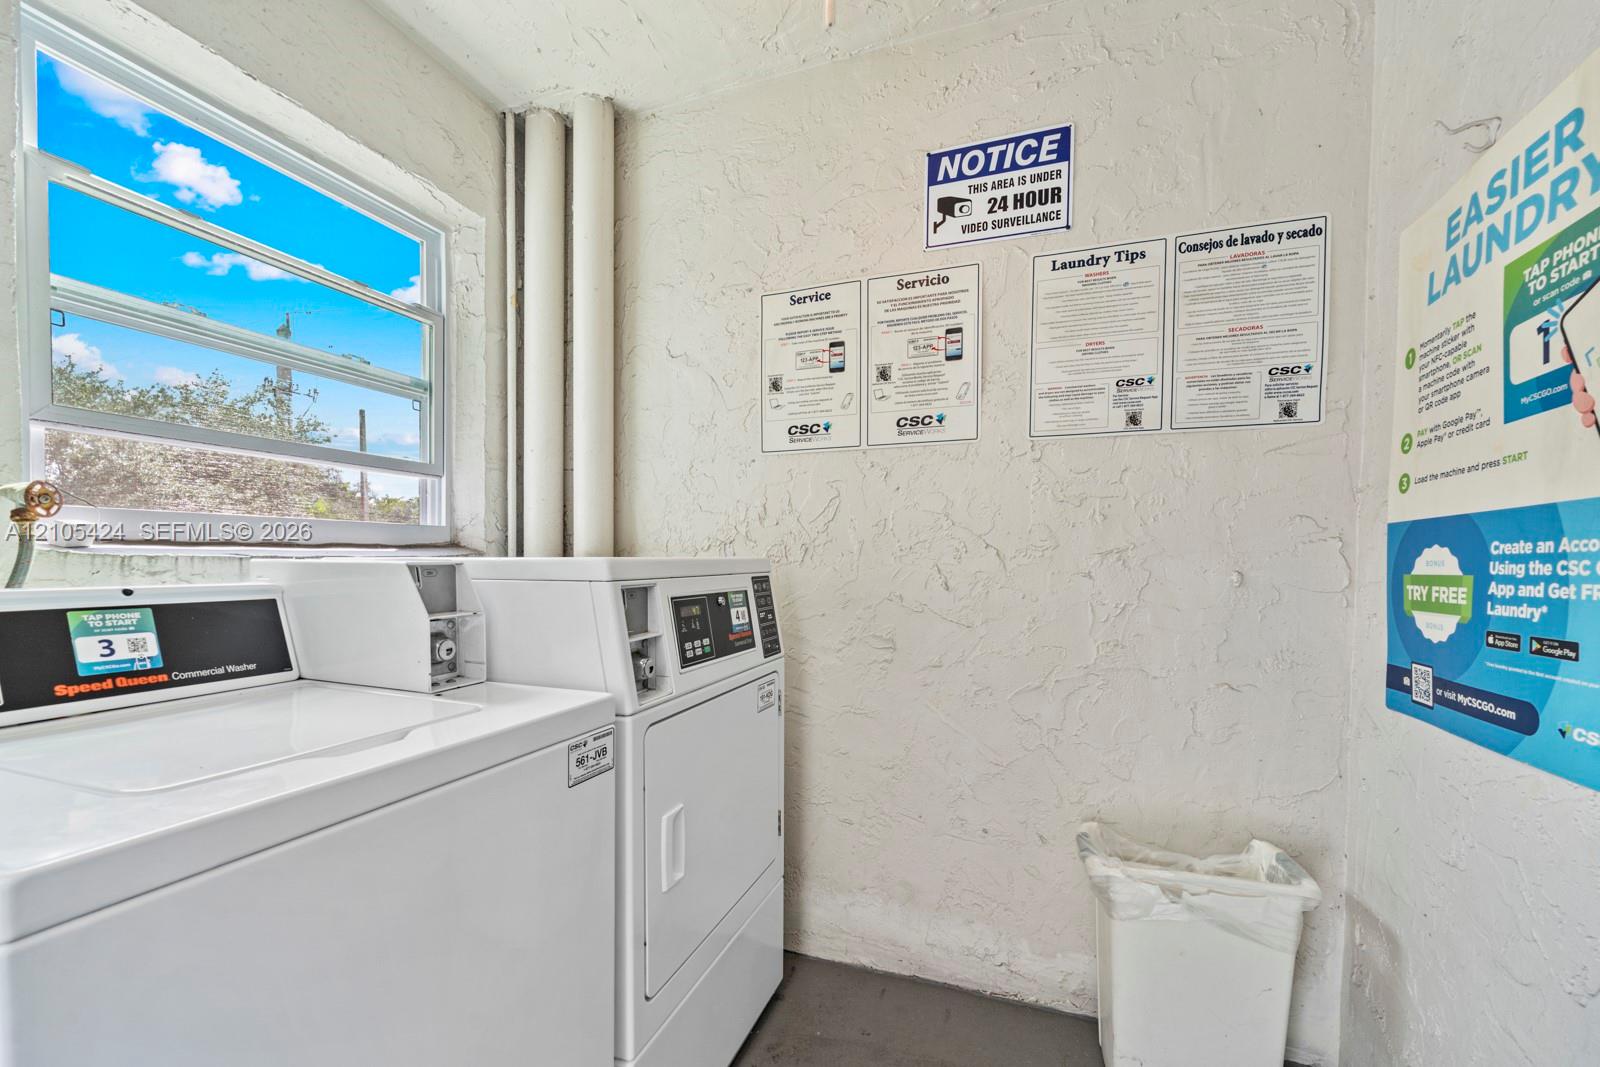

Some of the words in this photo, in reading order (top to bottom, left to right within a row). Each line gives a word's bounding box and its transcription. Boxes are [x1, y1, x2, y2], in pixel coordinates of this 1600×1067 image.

[936, 133, 1062, 182] NOTICE
[968, 182, 988, 195] THIS
[990, 177, 1015, 191] AREA
[1017, 176, 1027, 187] IS
[1030, 169, 1062, 183] UNDER
[1445, 107, 1585, 252] EASIER
[987, 195, 1009, 215] 24
[1012, 186, 1062, 211] HOUR
[961, 221, 988, 235] VIDEO
[991, 210, 1062, 230] SURVEILLANCE
[1426, 151, 1600, 306] LAUNDRY
[1178, 238, 1223, 254] Consejos
[1226, 235, 1239, 248] de
[1241, 230, 1275, 246] lavado
[1277, 231, 1284, 244] y
[1286, 224, 1323, 239] secado
[1051, 254, 1111, 272] Laundry
[1114, 248, 1147, 263] Tips
[1229, 250, 1266, 259] LAVADORAS
[1523, 257, 1550, 282] TAP
[1528, 277, 1547, 295] TO
[1550, 243, 1600, 284] START
[896, 273, 949, 291] Servicio
[1533, 298, 1541, 307] or
[1542, 288, 1559, 302] scan
[1560, 277, 1581, 293] code
[789, 291, 832, 306] Service
[1228, 324, 1264, 333] SECADORAS
[1419, 326, 1452, 349] Momentarily
[1452, 317, 1465, 330] TAP
[1465, 312, 1476, 323] the
[1419, 344, 1440, 361] machine
[1441, 332, 1460, 349] sticker
[1461, 324, 1475, 337] with
[1536, 319, 1550, 365] 1
[1418, 362, 1451, 382] smartphone,
[1452, 354, 1462, 365] OR
[1463, 343, 1482, 360] SCAN
[1419, 360, 1430, 373] your
[1431, 341, 1468, 364] NFC-capable
[1116, 377, 1145, 388] CSC
[1268, 366, 1302, 376] CSC
[1423, 375, 1445, 391] machine
[1446, 367, 1461, 379] code
[1461, 360, 1476, 371] with
[1418, 393, 1430, 405] your
[1430, 377, 1465, 398] smartphone
[1465, 366, 1490, 382] camera
[1417, 406, 1424, 414] or
[1424, 401, 1434, 411] QR
[1434, 395, 1448, 407] code
[1449, 390, 1462, 402] app
[788, 423, 821, 436] CSC
[896, 414, 934, 428] CSC
[1416, 428, 1429, 438] PAY
[1429, 424, 1441, 433] with
[1442, 417, 1464, 430] Google
[1416, 438, 1433, 448] Apple
[1447, 431, 1455, 439] or
[1455, 424, 1474, 436] credit
[1475, 417, 1491, 430] card
[1403, 437, 1410, 450] 2
[1414, 475, 1429, 485] Load
[1429, 472, 1439, 482] the
[1439, 467, 1465, 479] machine
[1466, 463, 1480, 473] and
[1481, 459, 1501, 471] press
[1502, 450, 1528, 465] START
[1401, 478, 1408, 490] 3
[1490, 540, 1533, 555] Create
[1536, 540, 1555, 554] an
[1489, 560, 1526, 578] Using
[1528, 560, 1553, 576] the
[1556, 559, 1591, 576] CSC
[1406, 585, 1429, 601] TRY
[1431, 586, 1467, 605] FREE
[1488, 581, 1515, 599] App
[1517, 582, 1545, 598] and
[1548, 582, 1577, 600] Get
[104, 612, 141, 620] PHONE
[104, 619, 138, 627] START
[97, 639, 116, 658] 3
[1494, 639, 1505, 647] App
[1505, 640, 1519, 649] Store
[1542, 646, 1564, 657] Google
[1563, 648, 1577, 659] Play
[53, 678, 113, 697] Speed
[115, 672, 169, 688] Queen
[171, 665, 225, 681] Commercial
[225, 662, 258, 673] Washer
[1436, 688, 1443, 696] or
[1443, 690, 1457, 702] visit
[1457, 693, 1516, 720] MyCSCGO.com
[570, 742, 583, 751] CSC
[575, 746, 608, 768] 561-JVB
